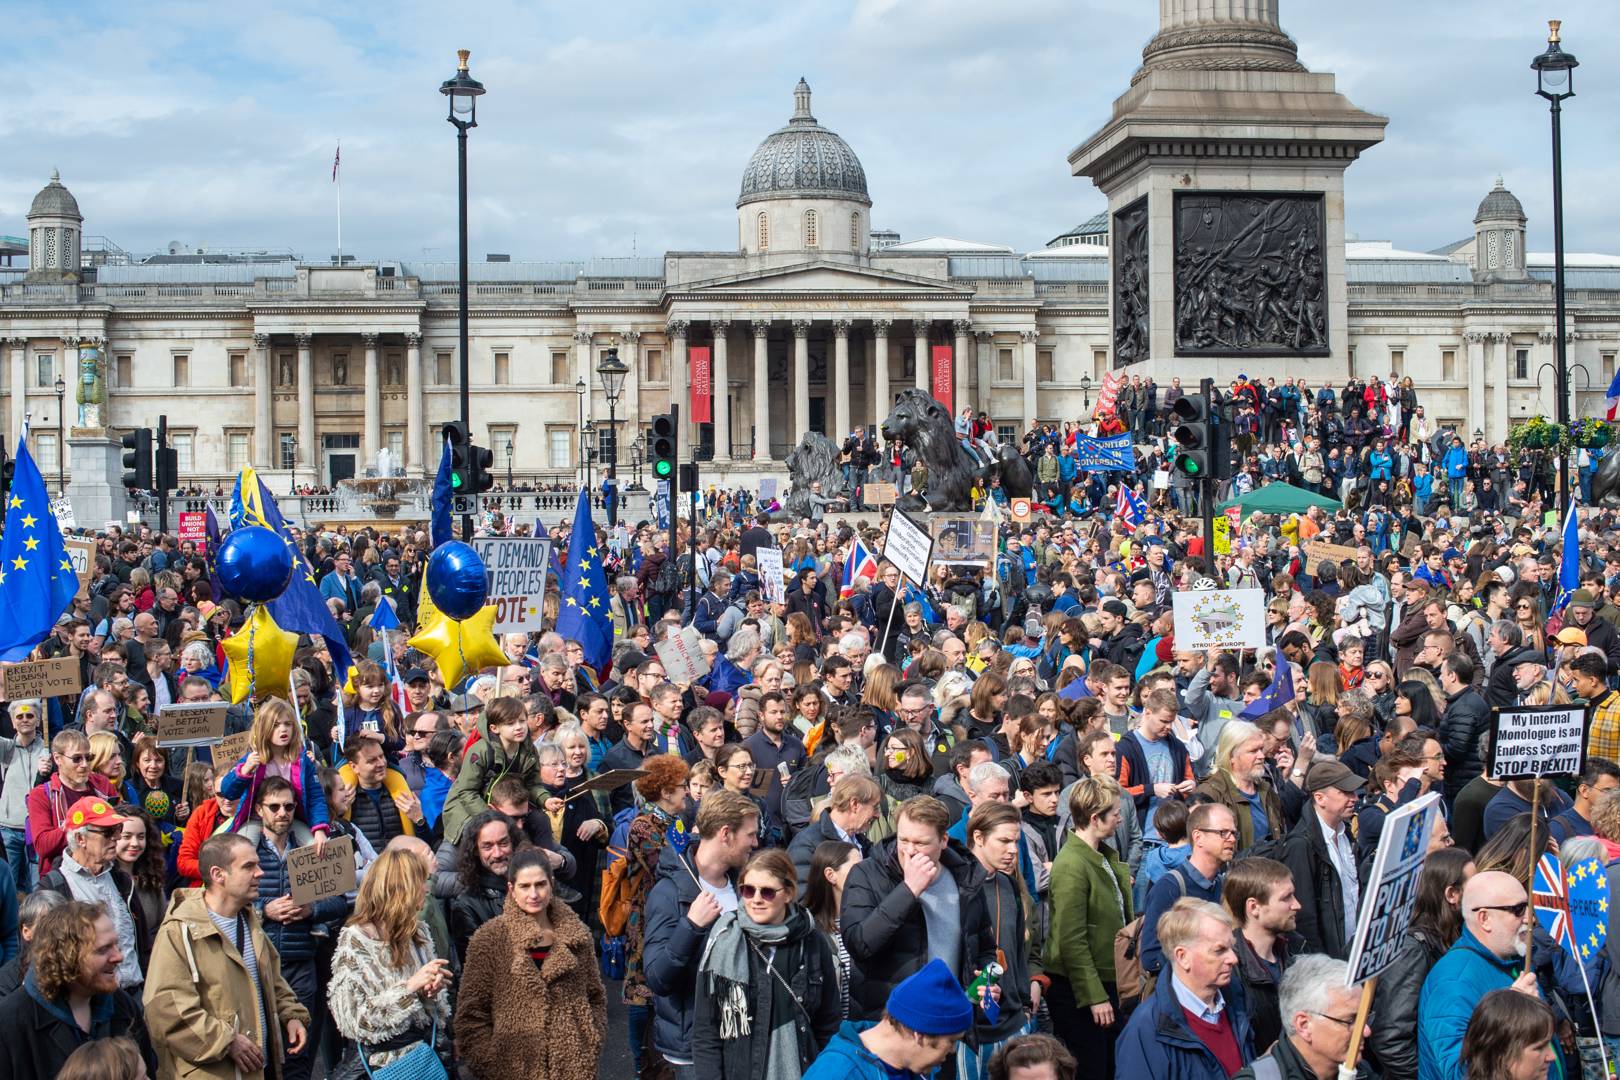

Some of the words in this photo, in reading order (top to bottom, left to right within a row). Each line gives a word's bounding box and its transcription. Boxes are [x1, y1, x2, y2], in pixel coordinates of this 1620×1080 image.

[1098, 439, 1130, 449] UNITED
[1112, 450, 1122, 458] IN
[1081, 458, 1123, 466] DIVERSITY
[497, 541, 544, 568] DEMAND
[486, 596, 528, 624] OTE
[7, 664, 45, 676] BREXIT
[51, 662, 61, 670] IS
[7, 671, 48, 682] RUBBISH
[8, 682, 27, 691] LET
[31, 680, 43, 688] US
[47, 677, 73, 687] VOTE
[8, 689, 43, 699] AGAIN
[165, 709, 177, 718] WE
[180, 707, 216, 717] DESERVE
[1511, 714, 1527, 727] My
[1529, 712, 1570, 726] Internal
[175, 716, 209, 726] BETTER
[163, 727, 185, 736] VOTE
[187, 725, 211, 735] AGAIN
[1498, 728, 1556, 741] Monologue
[1558, 726, 1568, 738] is
[1569, 727, 1581, 737] an
[1496, 744, 1538, 757] Endless
[1540, 743, 1580, 755] Scream:
[1495, 760, 1528, 775] STOP
[1530, 757, 1577, 773] BREXIT!
[291, 852, 317, 869] VOTE
[295, 866, 328, 887] BREXIT
[332, 862, 343, 875] IS
[314, 878, 337, 896] LIES
[1373, 875, 1409, 919] PUT
[1366, 914, 1389, 951] TO
[1389, 896, 1416, 938] THE
[1356, 933, 1405, 979] PEOPLE
